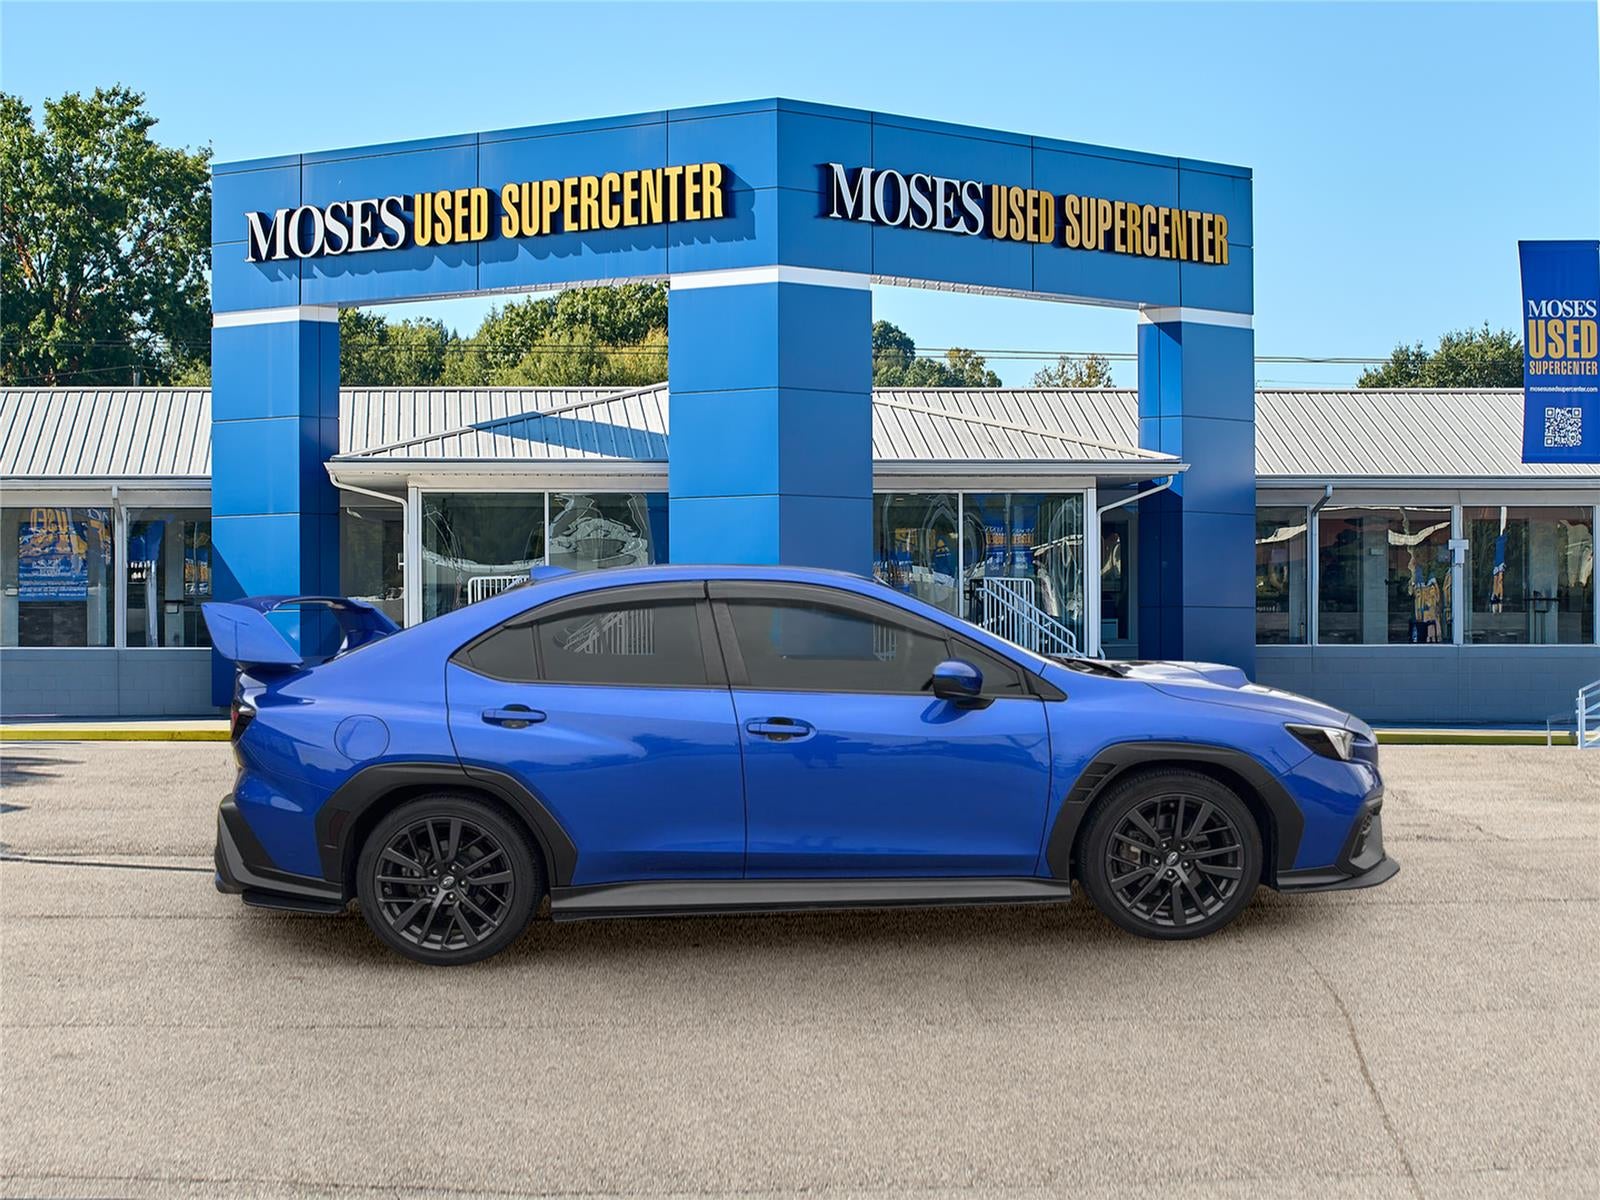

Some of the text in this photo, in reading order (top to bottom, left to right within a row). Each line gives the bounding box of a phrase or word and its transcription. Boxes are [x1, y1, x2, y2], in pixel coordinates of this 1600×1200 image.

[245, 162, 724, 263] MOSES USED SUPERCENTER
[829, 162, 1230, 265] MOSES USED SUPERCENTER
[1528, 299, 1597, 318] MOSES
[1528, 319, 1598, 359] USED
[1529, 360, 1598, 375] SUPERCENTER
